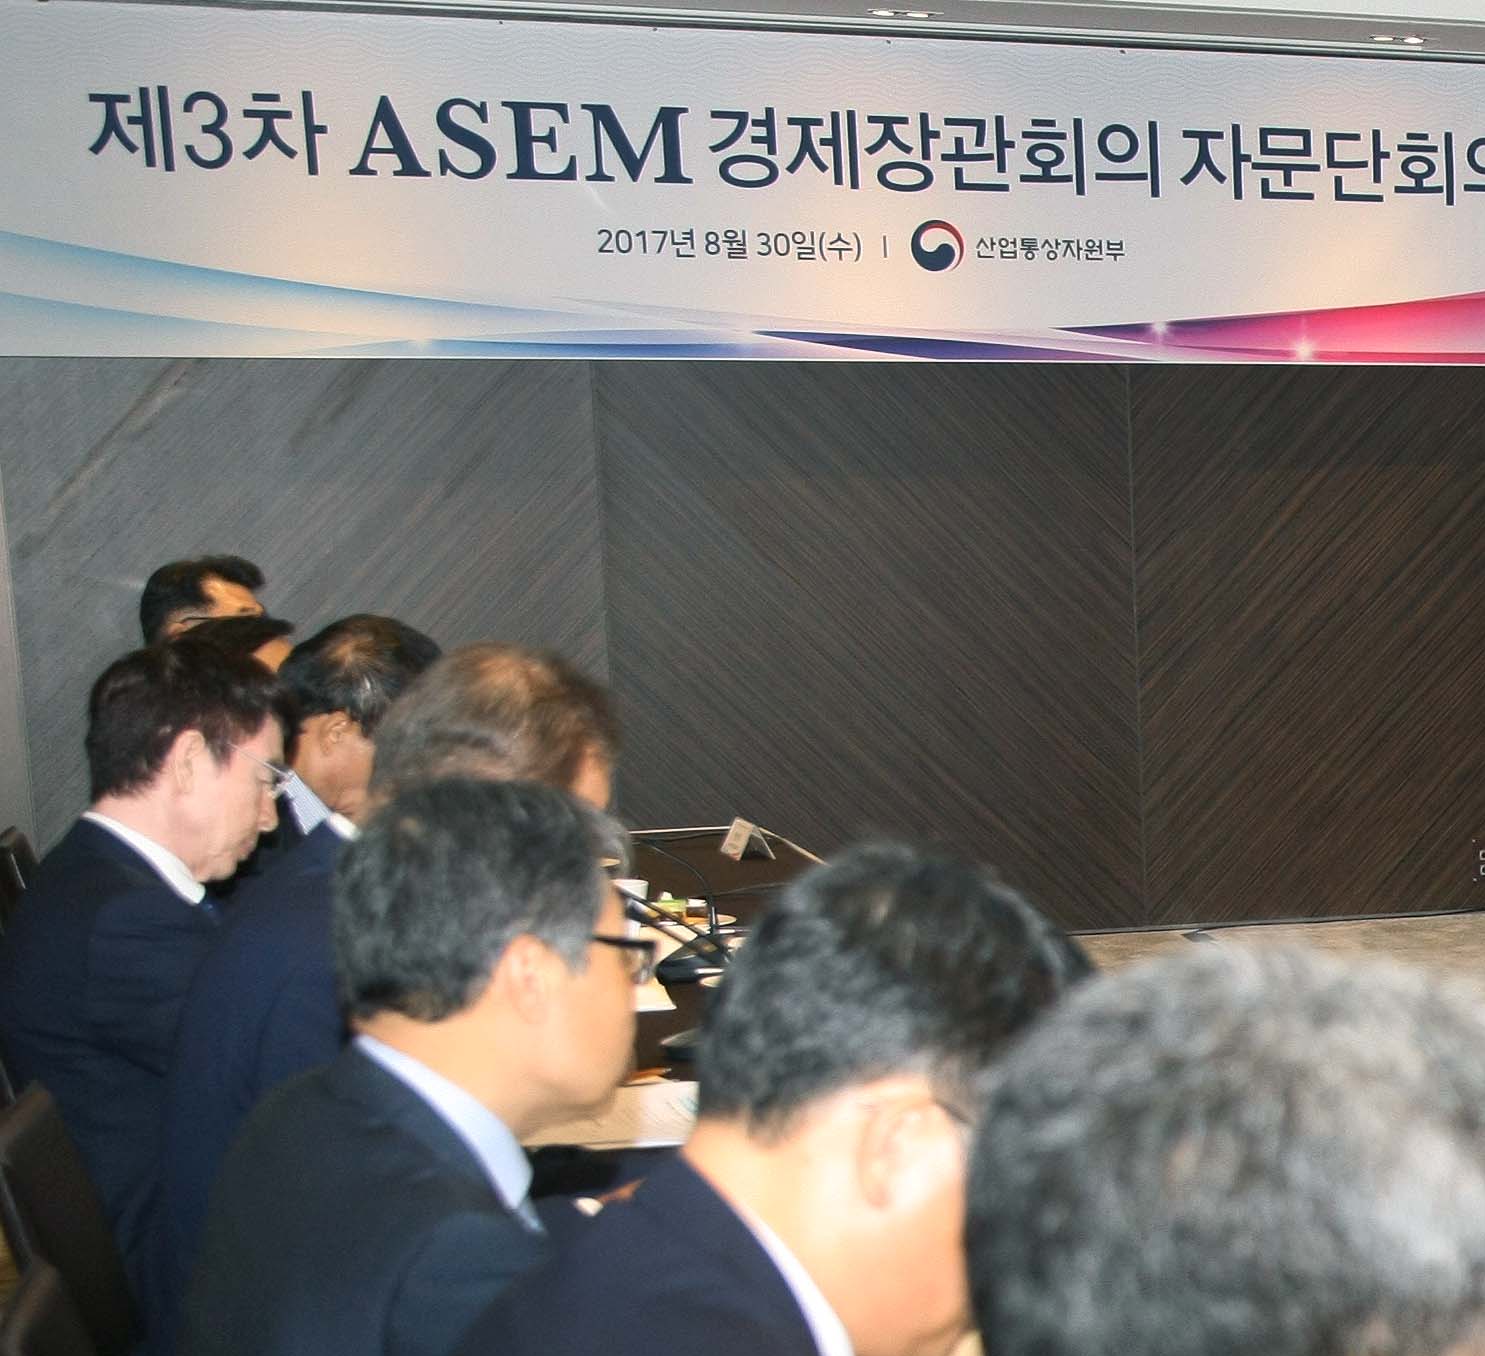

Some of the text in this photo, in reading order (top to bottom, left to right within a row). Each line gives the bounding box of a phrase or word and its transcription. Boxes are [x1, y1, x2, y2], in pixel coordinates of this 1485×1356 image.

[88, 84, 328, 176] 제3차
[349, 95, 694, 184] ASEM
[708, 106, 1162, 199] 경제장관회의
[597, 228, 862, 262] 2017년 8월 30일(수)
[975, 235, 1126, 262] 산업통상자원부
